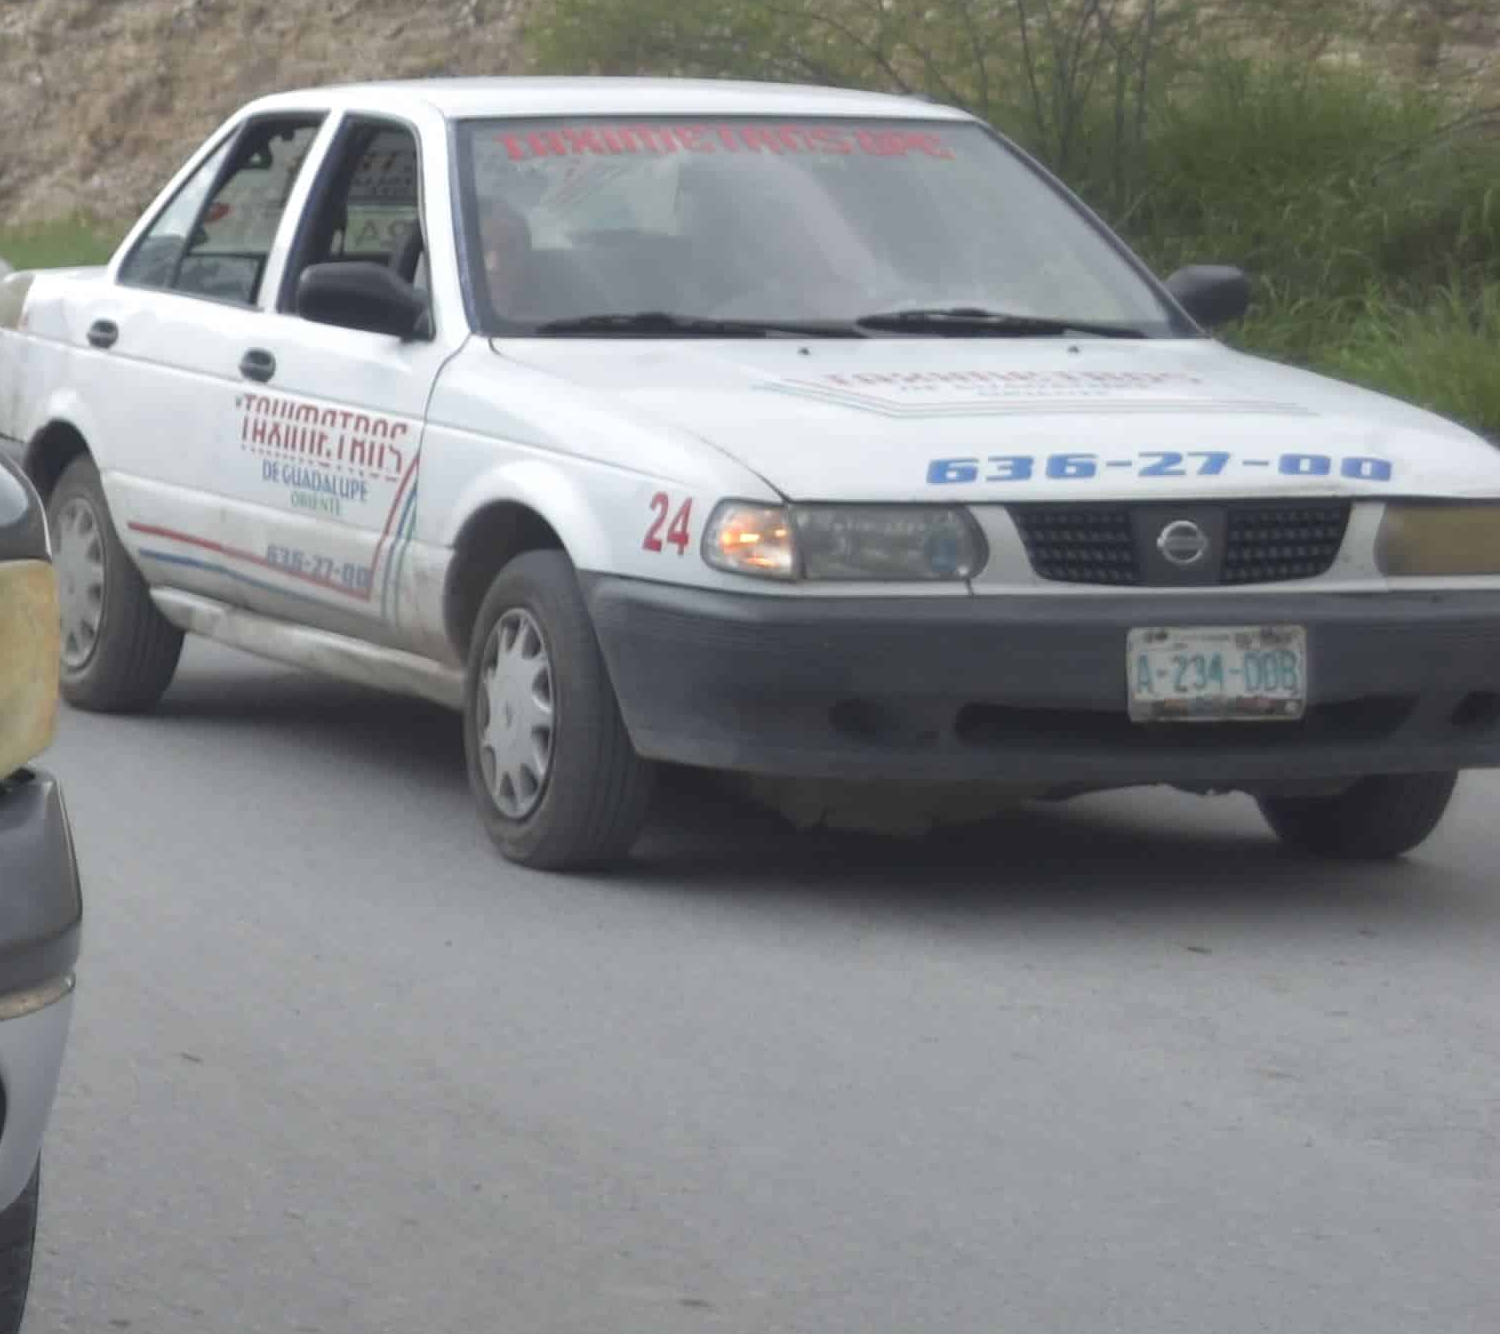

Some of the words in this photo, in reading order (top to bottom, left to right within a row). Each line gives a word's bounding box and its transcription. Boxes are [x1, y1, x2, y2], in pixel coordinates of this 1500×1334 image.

[240, 393, 409, 482] TAXIMETROS
[261, 459, 280, 483] DE
[281, 463, 368, 502] GUADALUPE
[925, 451, 1393, 485] 636-27-00
[642, 490, 694, 556] 24
